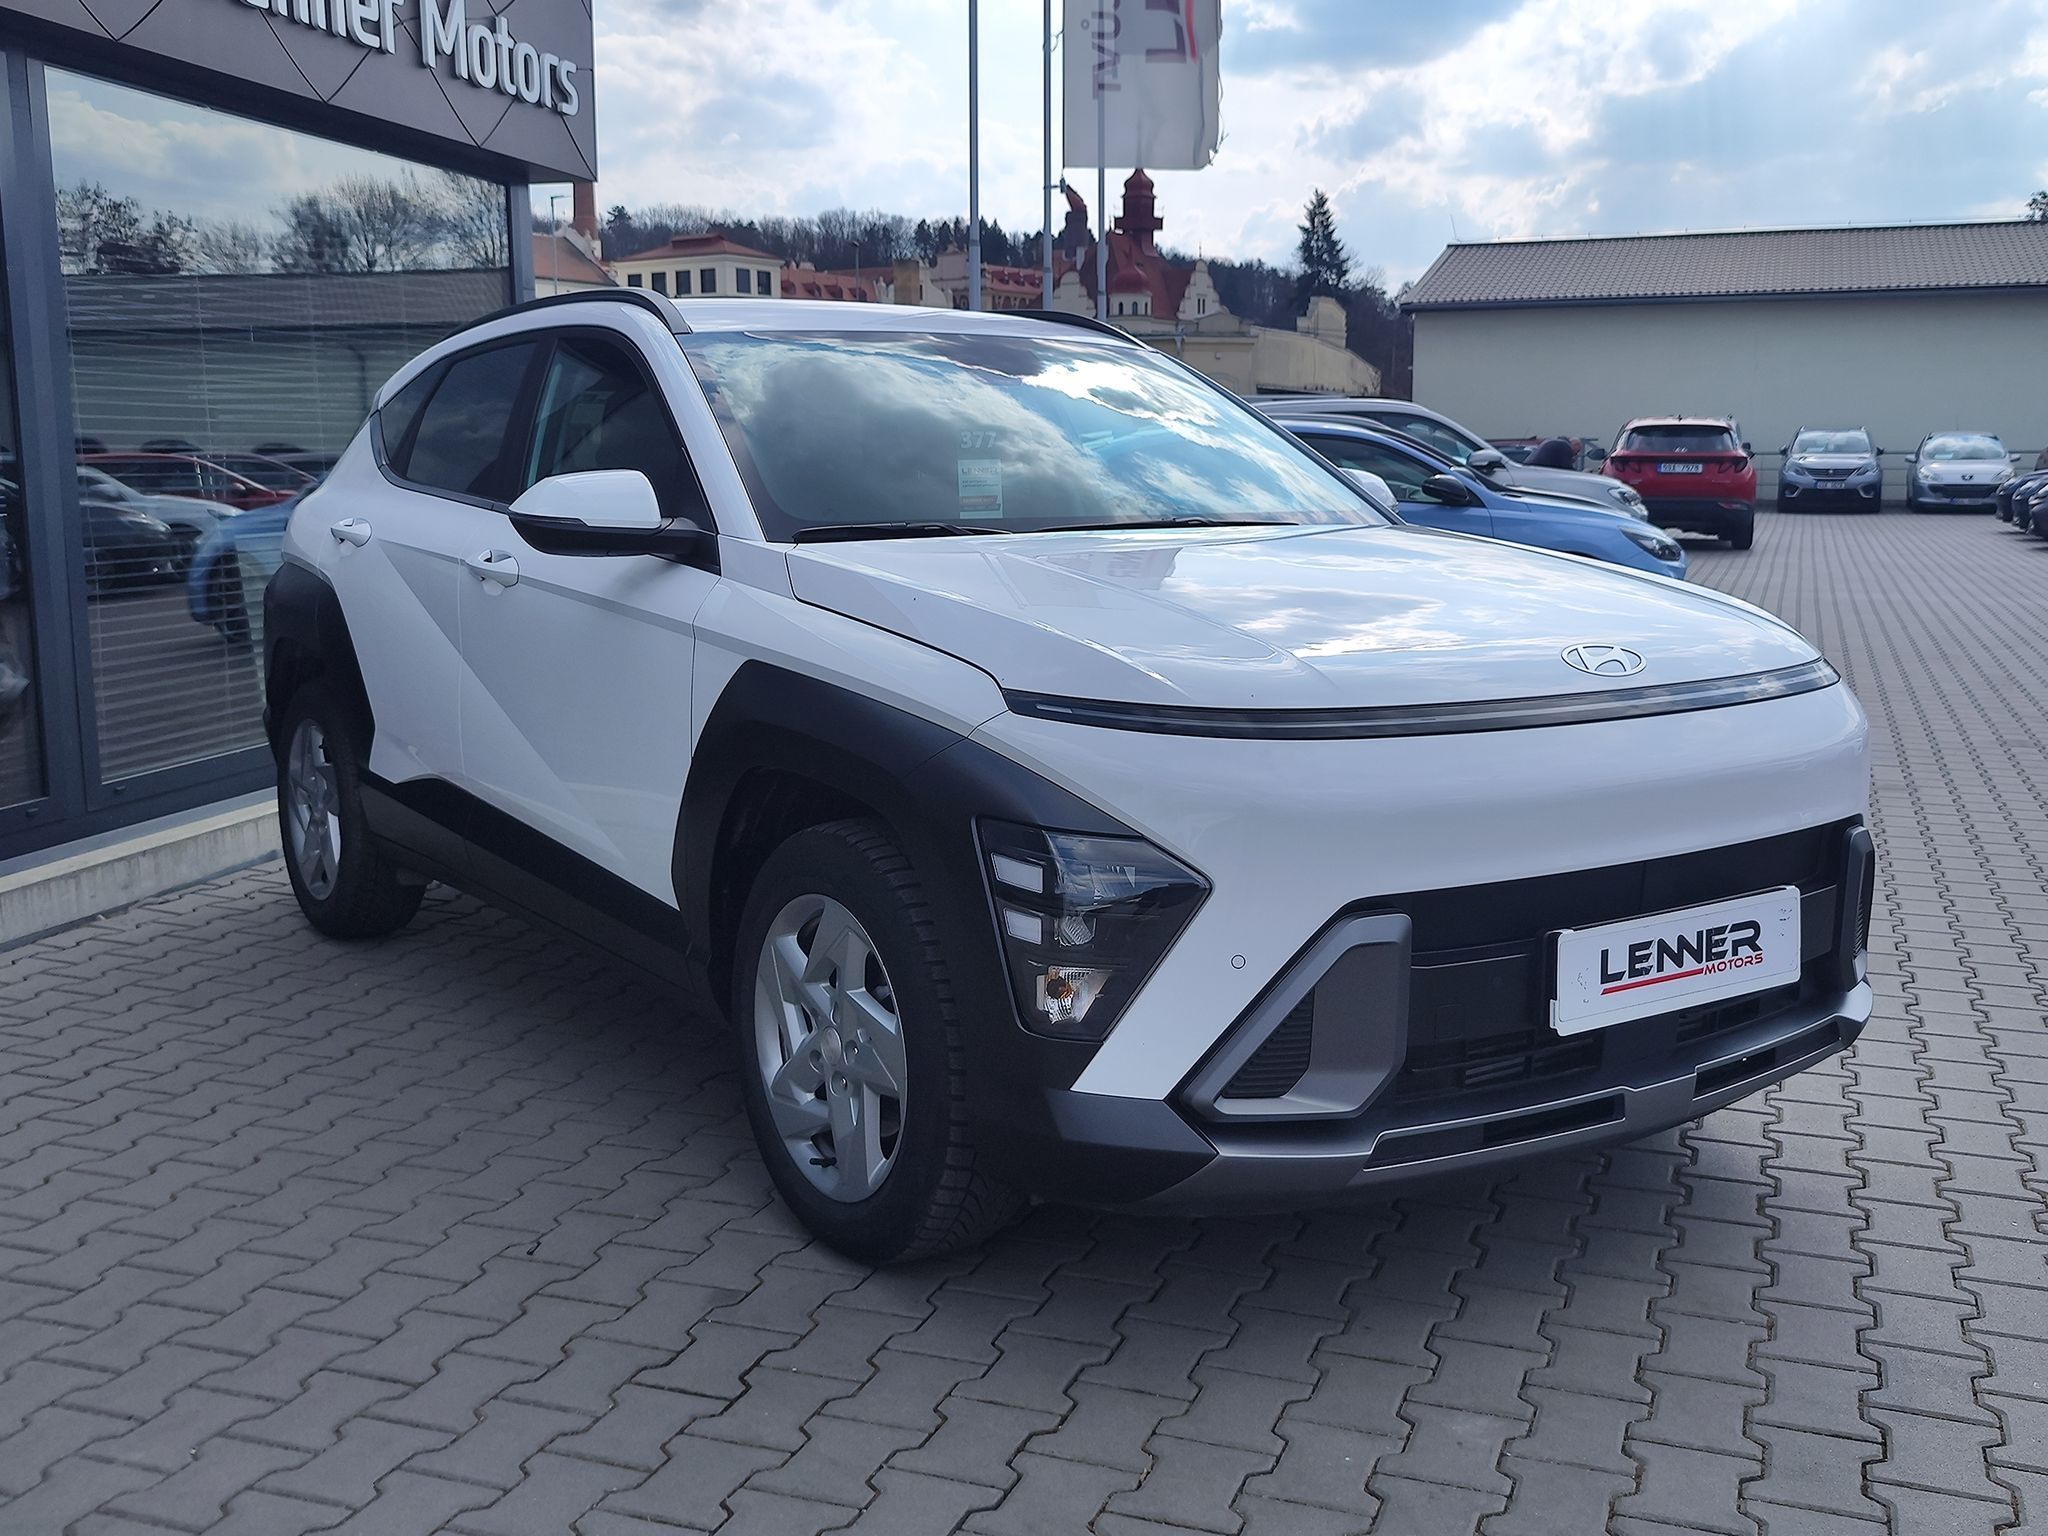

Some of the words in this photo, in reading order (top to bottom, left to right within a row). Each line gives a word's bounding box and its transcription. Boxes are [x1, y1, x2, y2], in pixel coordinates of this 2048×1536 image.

[418, 0, 580, 116] Motors
[960, 431, 997, 449] 377
[1600, 919, 1763, 984] LENNER
[1703, 952, 1764, 976] MOTORS
